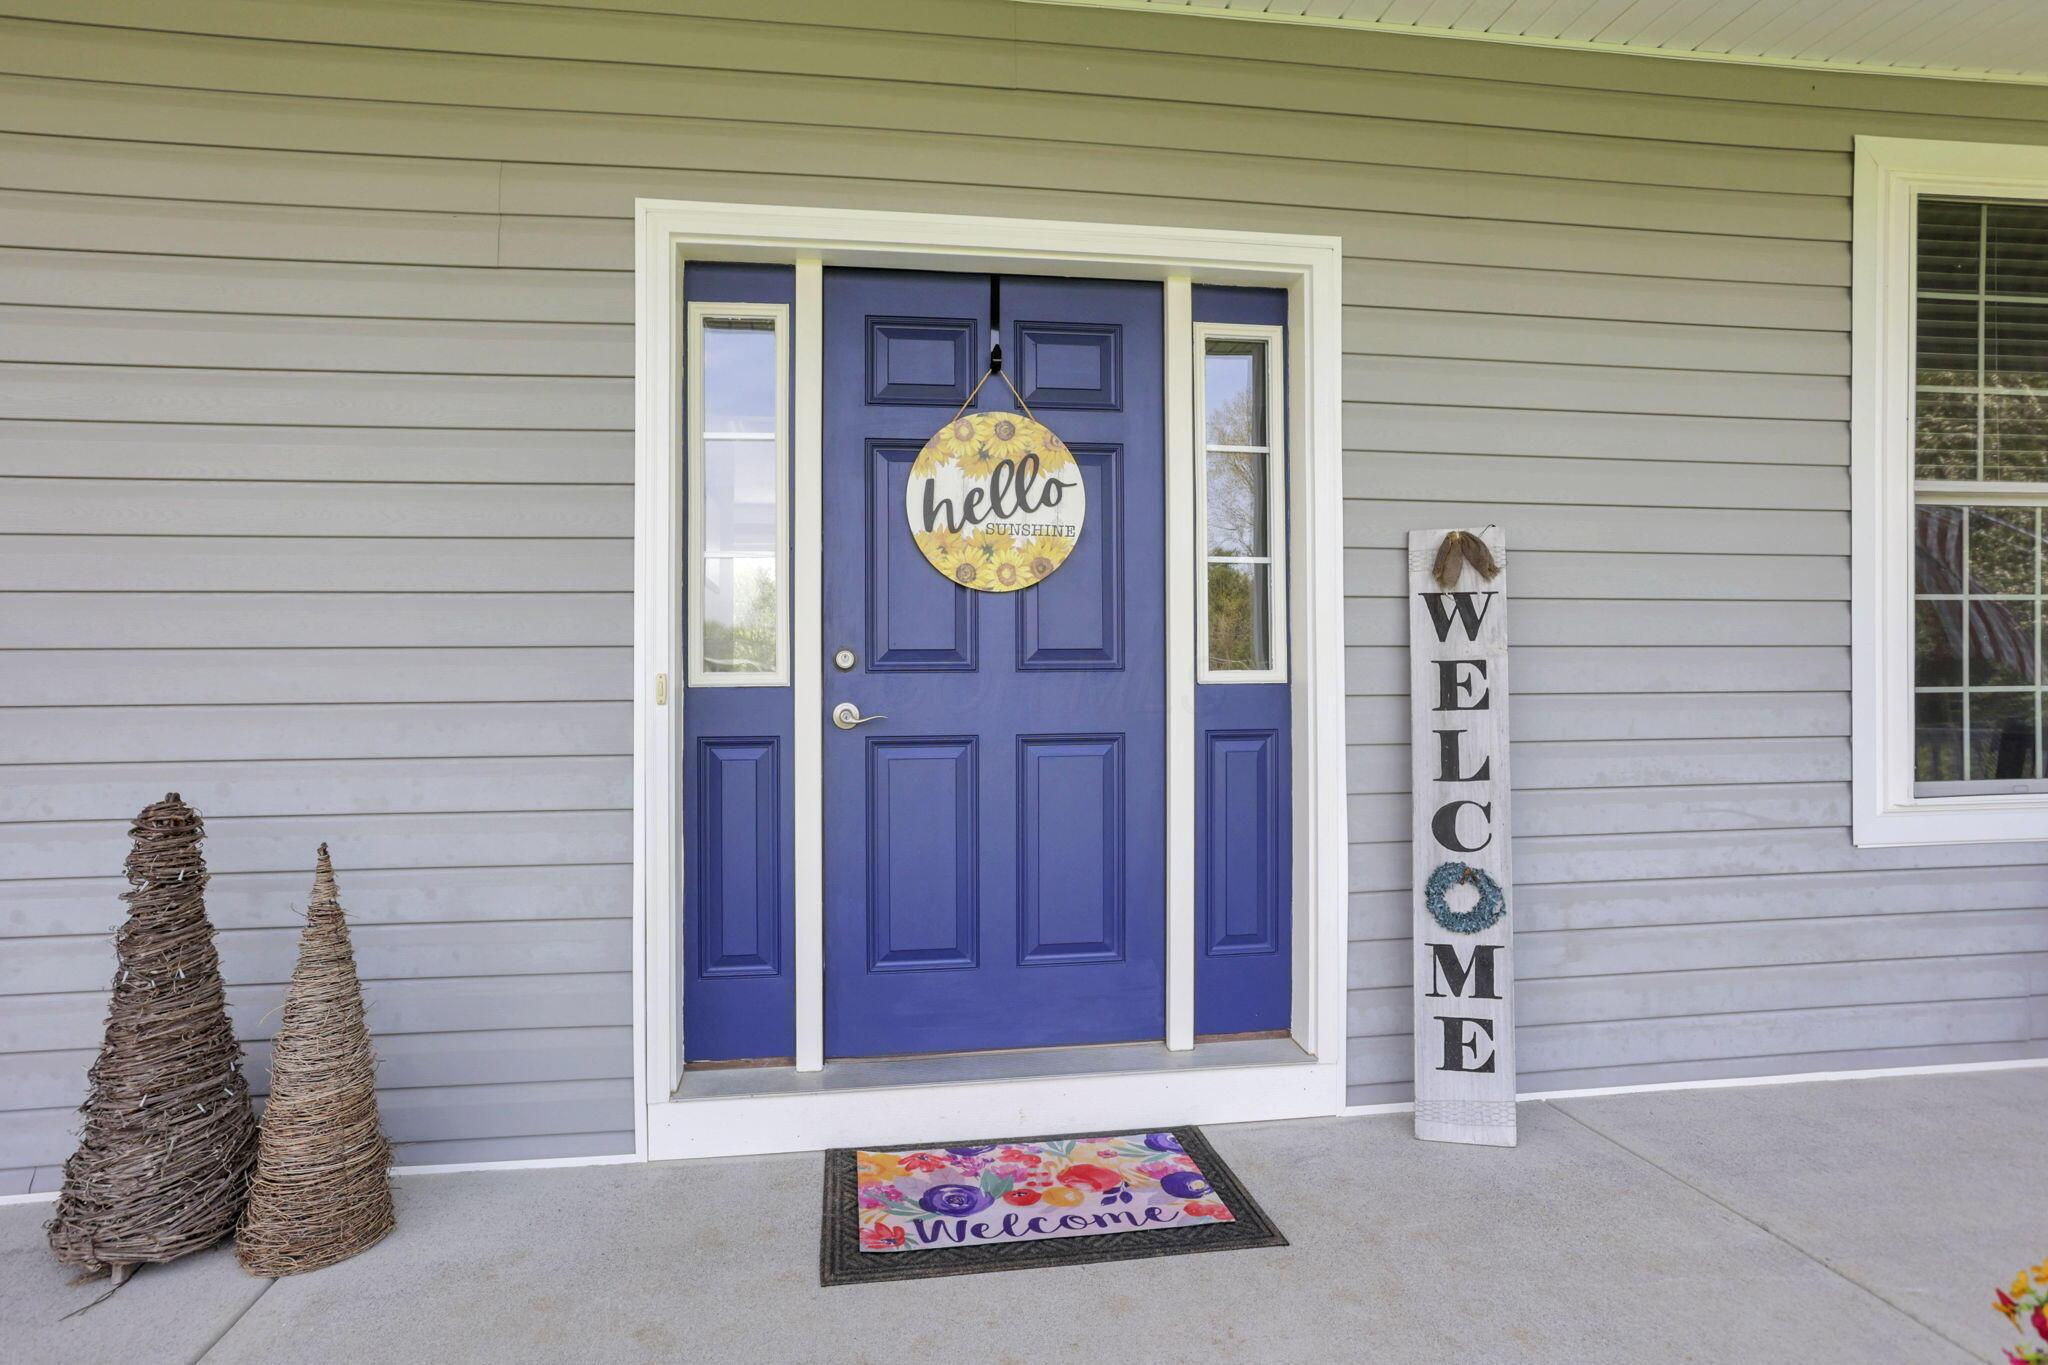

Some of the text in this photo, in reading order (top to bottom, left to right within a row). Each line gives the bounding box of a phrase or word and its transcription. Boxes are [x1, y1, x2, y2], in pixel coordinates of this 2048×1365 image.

[922, 453, 1078, 534] hello
[985, 522, 1076, 538] SUNSHINE
[1417, 591, 1507, 1074] WELCOME
[912, 1206, 1180, 1243] Welcome
